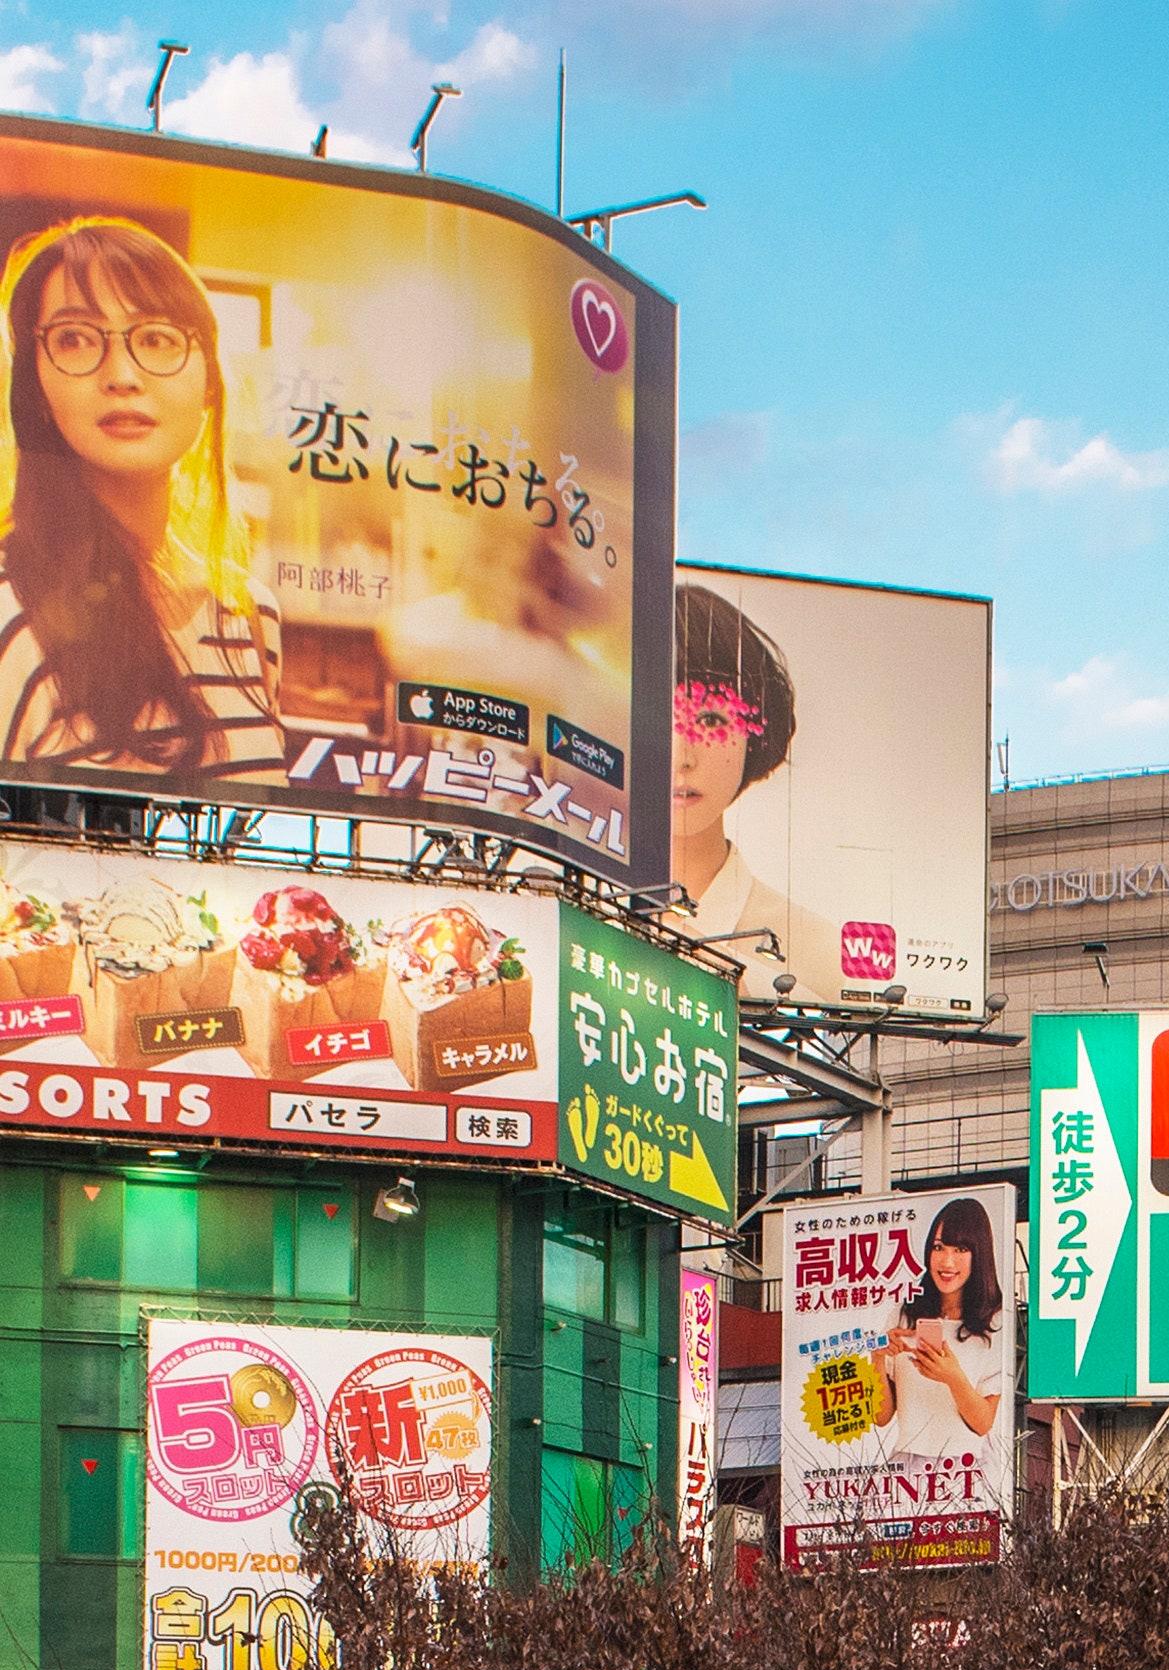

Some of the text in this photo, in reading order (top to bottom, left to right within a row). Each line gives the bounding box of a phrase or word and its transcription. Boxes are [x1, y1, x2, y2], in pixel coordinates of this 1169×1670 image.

[276, 561, 393, 600] 阿部桃子
[443, 691, 517, 721] App Store
[442, 711, 526, 741] からダウンロード
[571, 733, 599, 763] Google
[288, 737, 625, 856] ハッピーメール
[906, 954, 969, 972] ワクワク
[570, 943, 728, 1038] 豪華カプセルホテル
[152, 1017, 225, 1043] バナナ
[303, 1029, 372, 1056] イチゴ
[441, 1042, 528, 1070] キャラメル
[569, 990, 729, 1123] 安心お宿
[0, 1071, 212, 1127] SORTS
[285, 1103, 383, 1132] パセラ
[468, 1114, 520, 1142] 検索
[605, 1095, 689, 1147] ガードくぐって
[603, 1122, 665, 1184] 30秒
[794, 1208, 917, 1234] 女性のための稼げる
[1051, 1110, 1095, 1301] 徒歩2分
[795, 1228, 924, 1289] 高収入
[794, 1281, 922, 1313] 求人情報サイト
[820, 1360, 858, 1386] 現金
[151, 1374, 285, 1475] 5円
[340, 1377, 428, 1473] 新
[425, 1425, 481, 1452] 47枚
[183, 1468, 291, 1506] スロット
[359, 1464, 484, 1510] スロット
